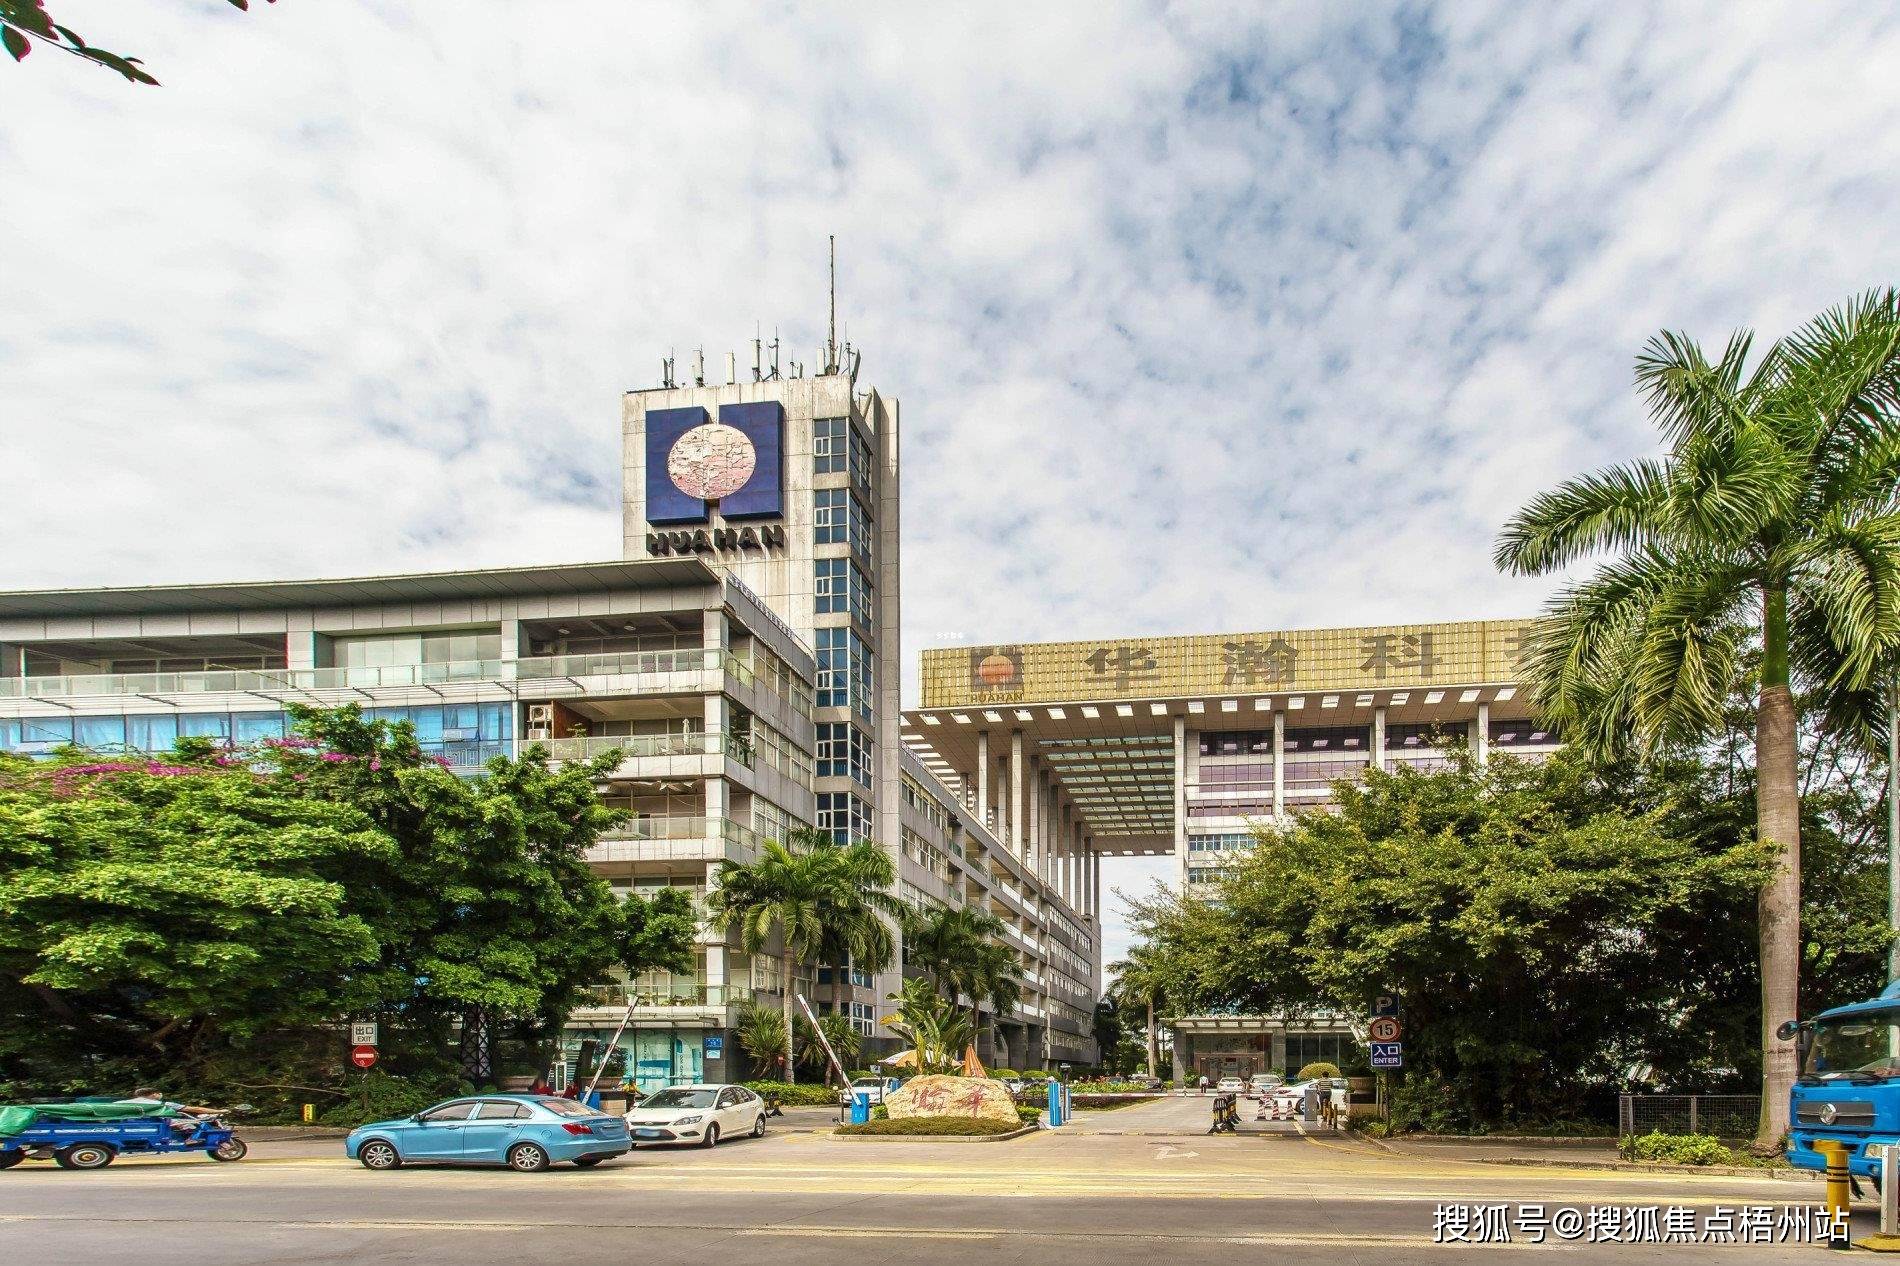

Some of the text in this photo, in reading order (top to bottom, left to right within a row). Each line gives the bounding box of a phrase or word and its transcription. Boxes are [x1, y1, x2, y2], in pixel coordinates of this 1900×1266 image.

[646, 526, 785, 556] HUAHAN
[1084, 627, 1538, 692] 华瀚科
[970, 691, 1024, 704] HUAHAN
[1376, 997, 1392, 1014] P
[356, 1026, 374, 1035] 出口
[1376, 1024, 1394, 1036] 15
[1374, 1046, 1398, 1056] 入口
